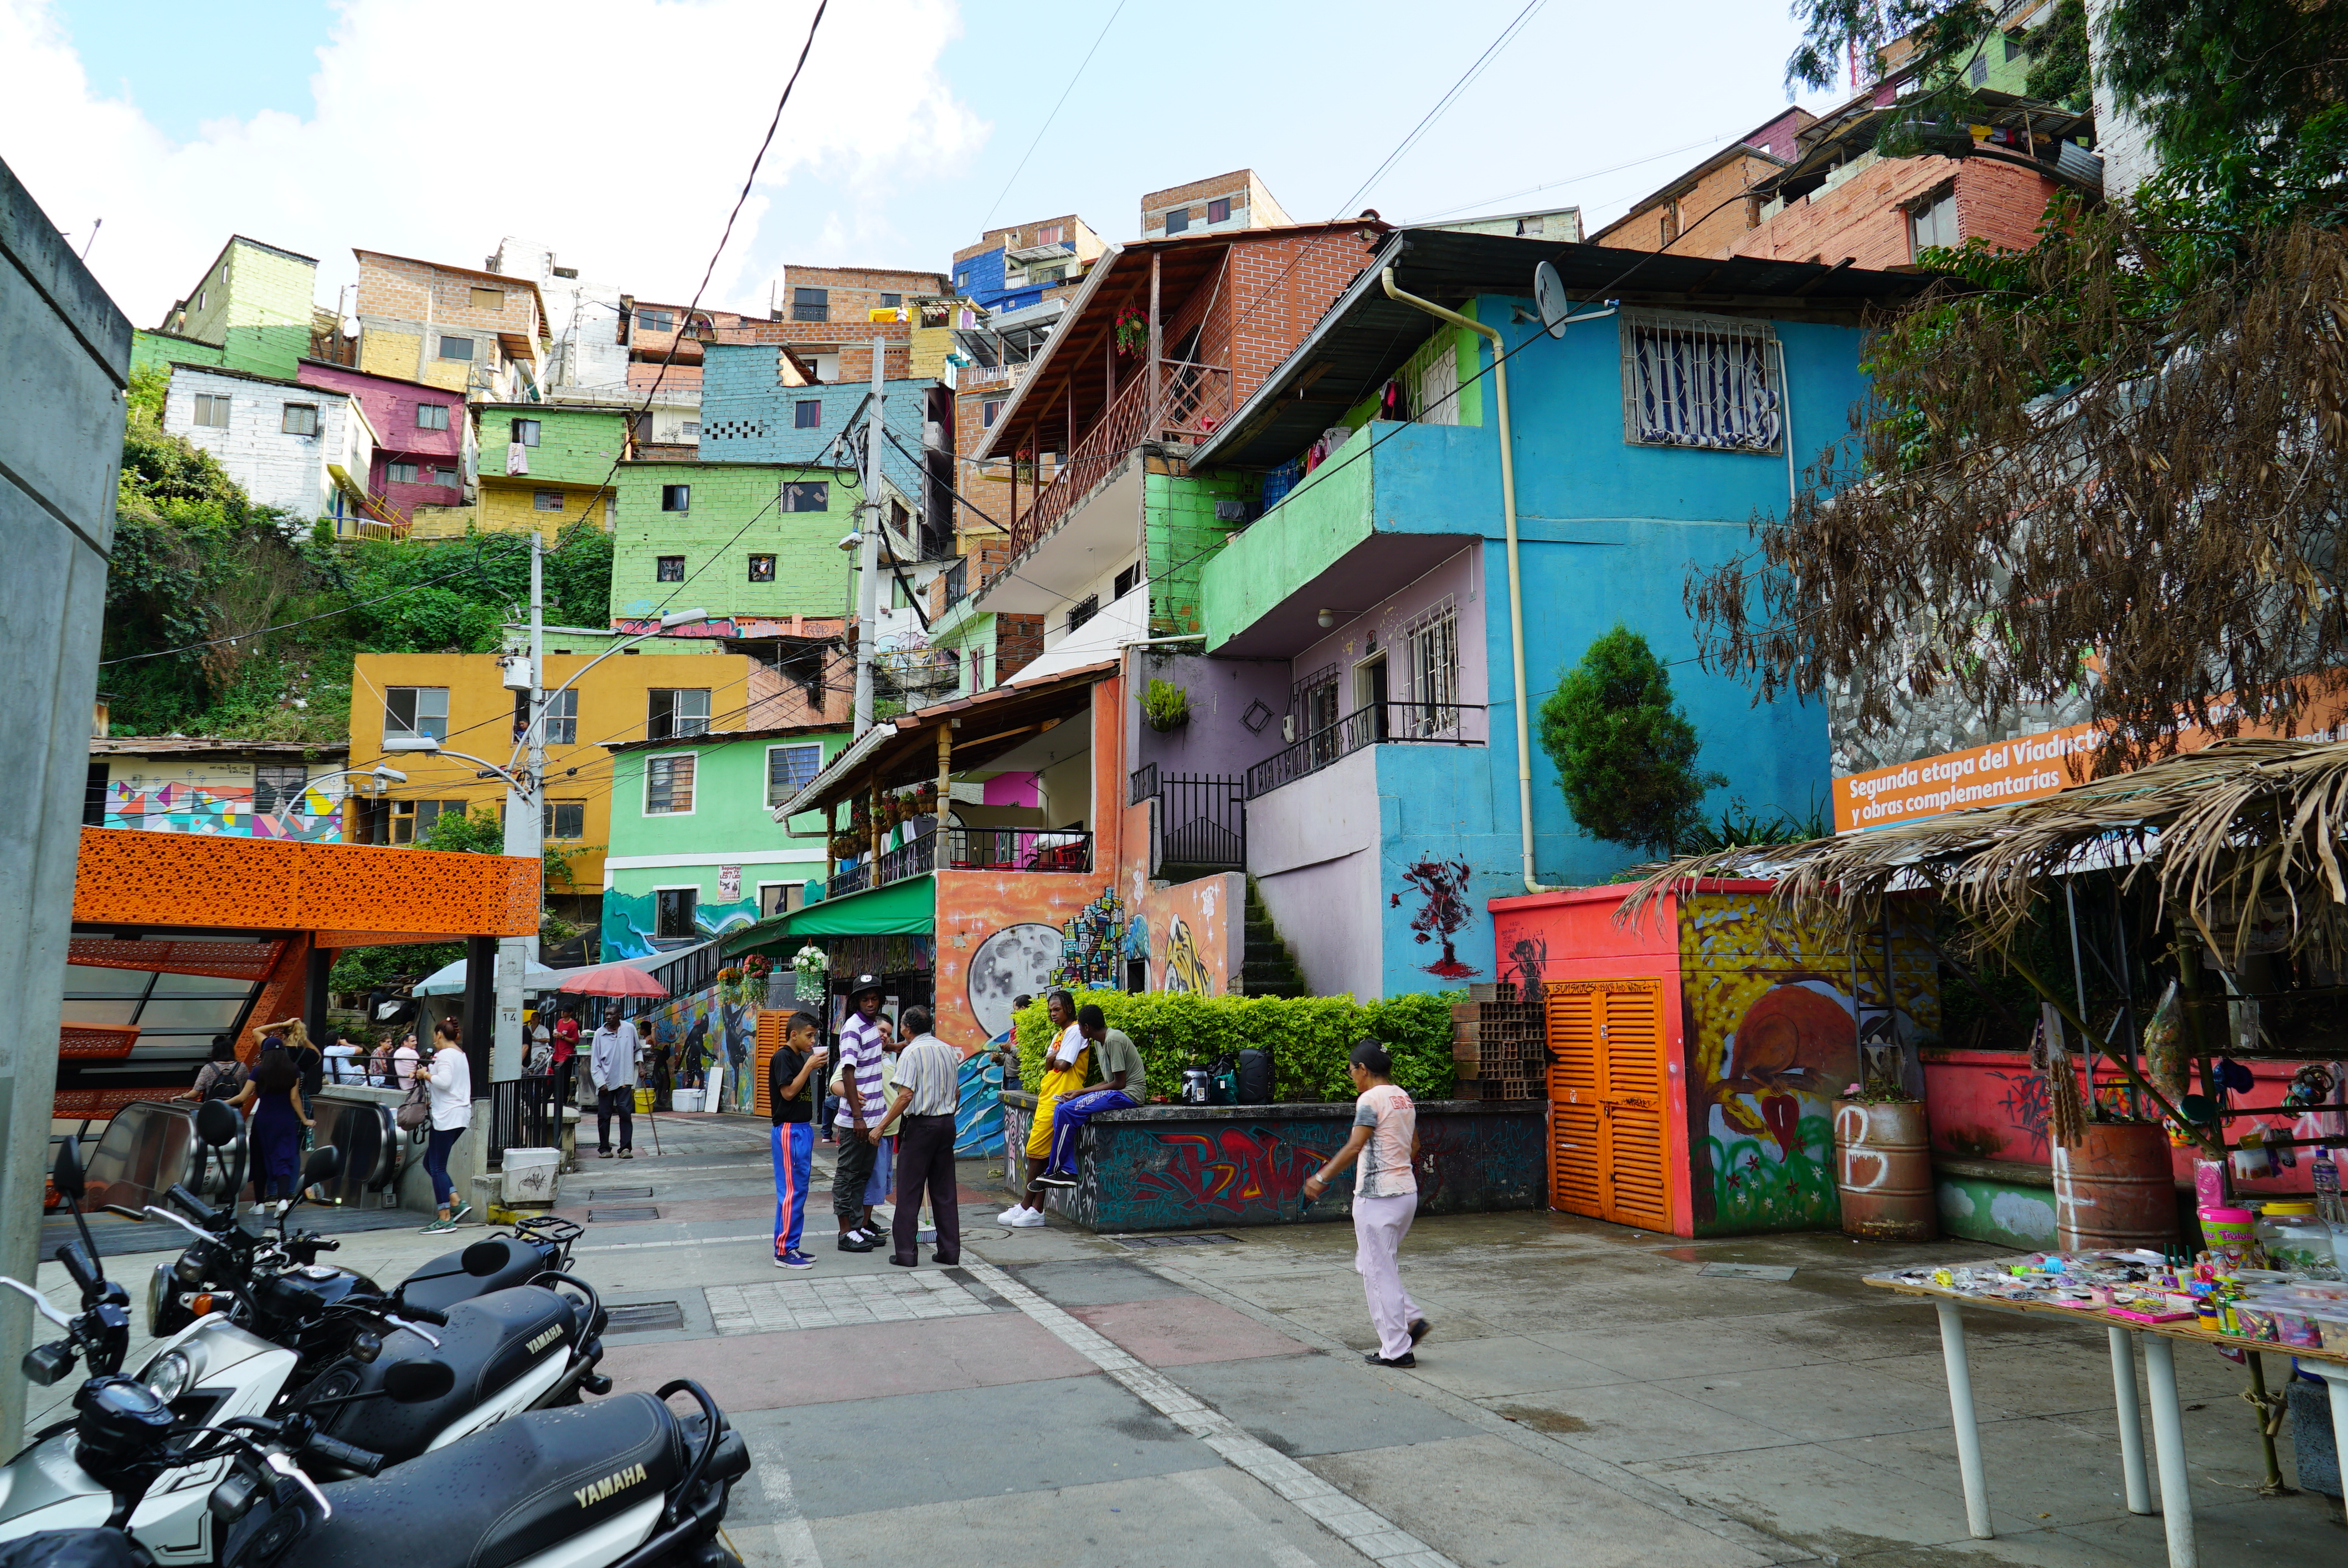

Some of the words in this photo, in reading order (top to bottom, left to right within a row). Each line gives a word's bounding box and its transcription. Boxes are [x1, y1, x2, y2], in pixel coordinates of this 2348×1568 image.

[1850, 767, 1918, 800] Segunda
[1921, 757, 1974, 783] etapa
[1979, 749, 2008, 772] del
[1851, 807, 1860, 826] y
[1862, 799, 1903, 820] obras
[1906, 768, 2059, 811] complementarias
[503, 1013, 516, 1022] 14
[2218, 1229, 2254, 1241] Trululu
[526, 1323, 564, 1354] YAMAHA
[574, 1462, 647, 1508] YAMAHA
